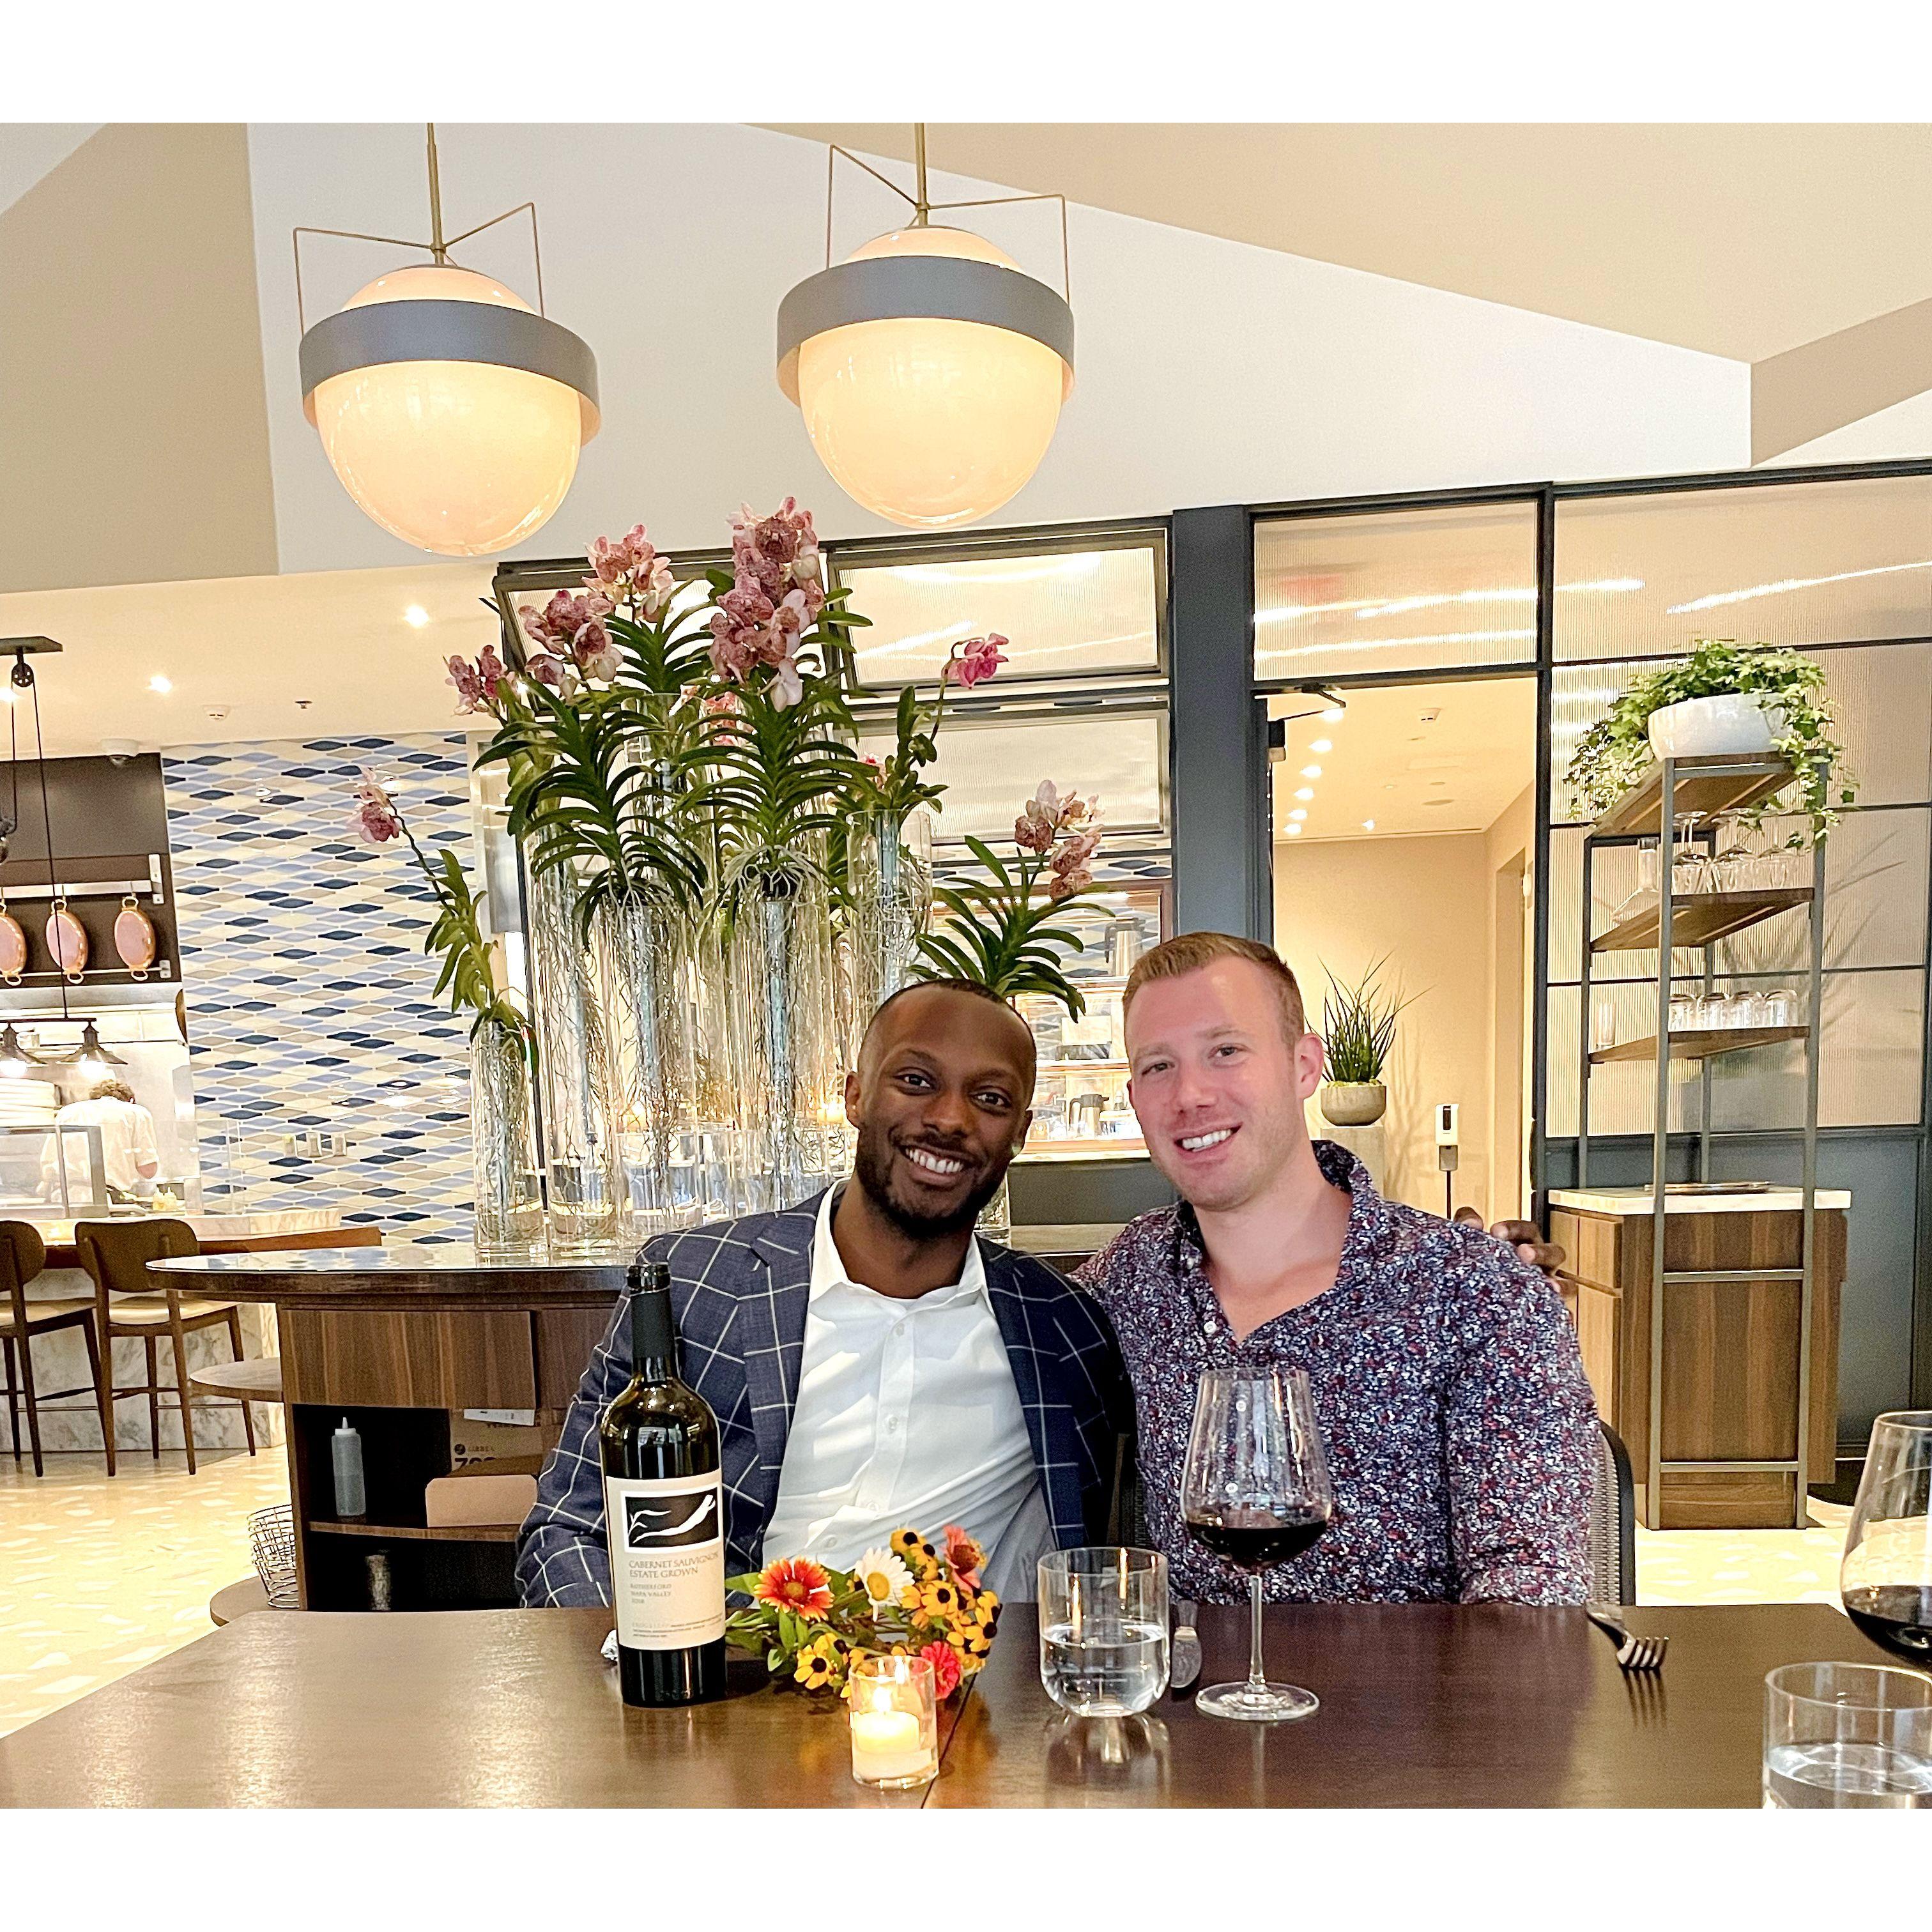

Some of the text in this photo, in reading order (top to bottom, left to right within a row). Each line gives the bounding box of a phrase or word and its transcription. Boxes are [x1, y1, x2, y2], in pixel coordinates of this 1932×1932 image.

[629, 1560, 672, 1568] CABERNET
[629, 1567, 698, 1578] ESTATE GROWN
